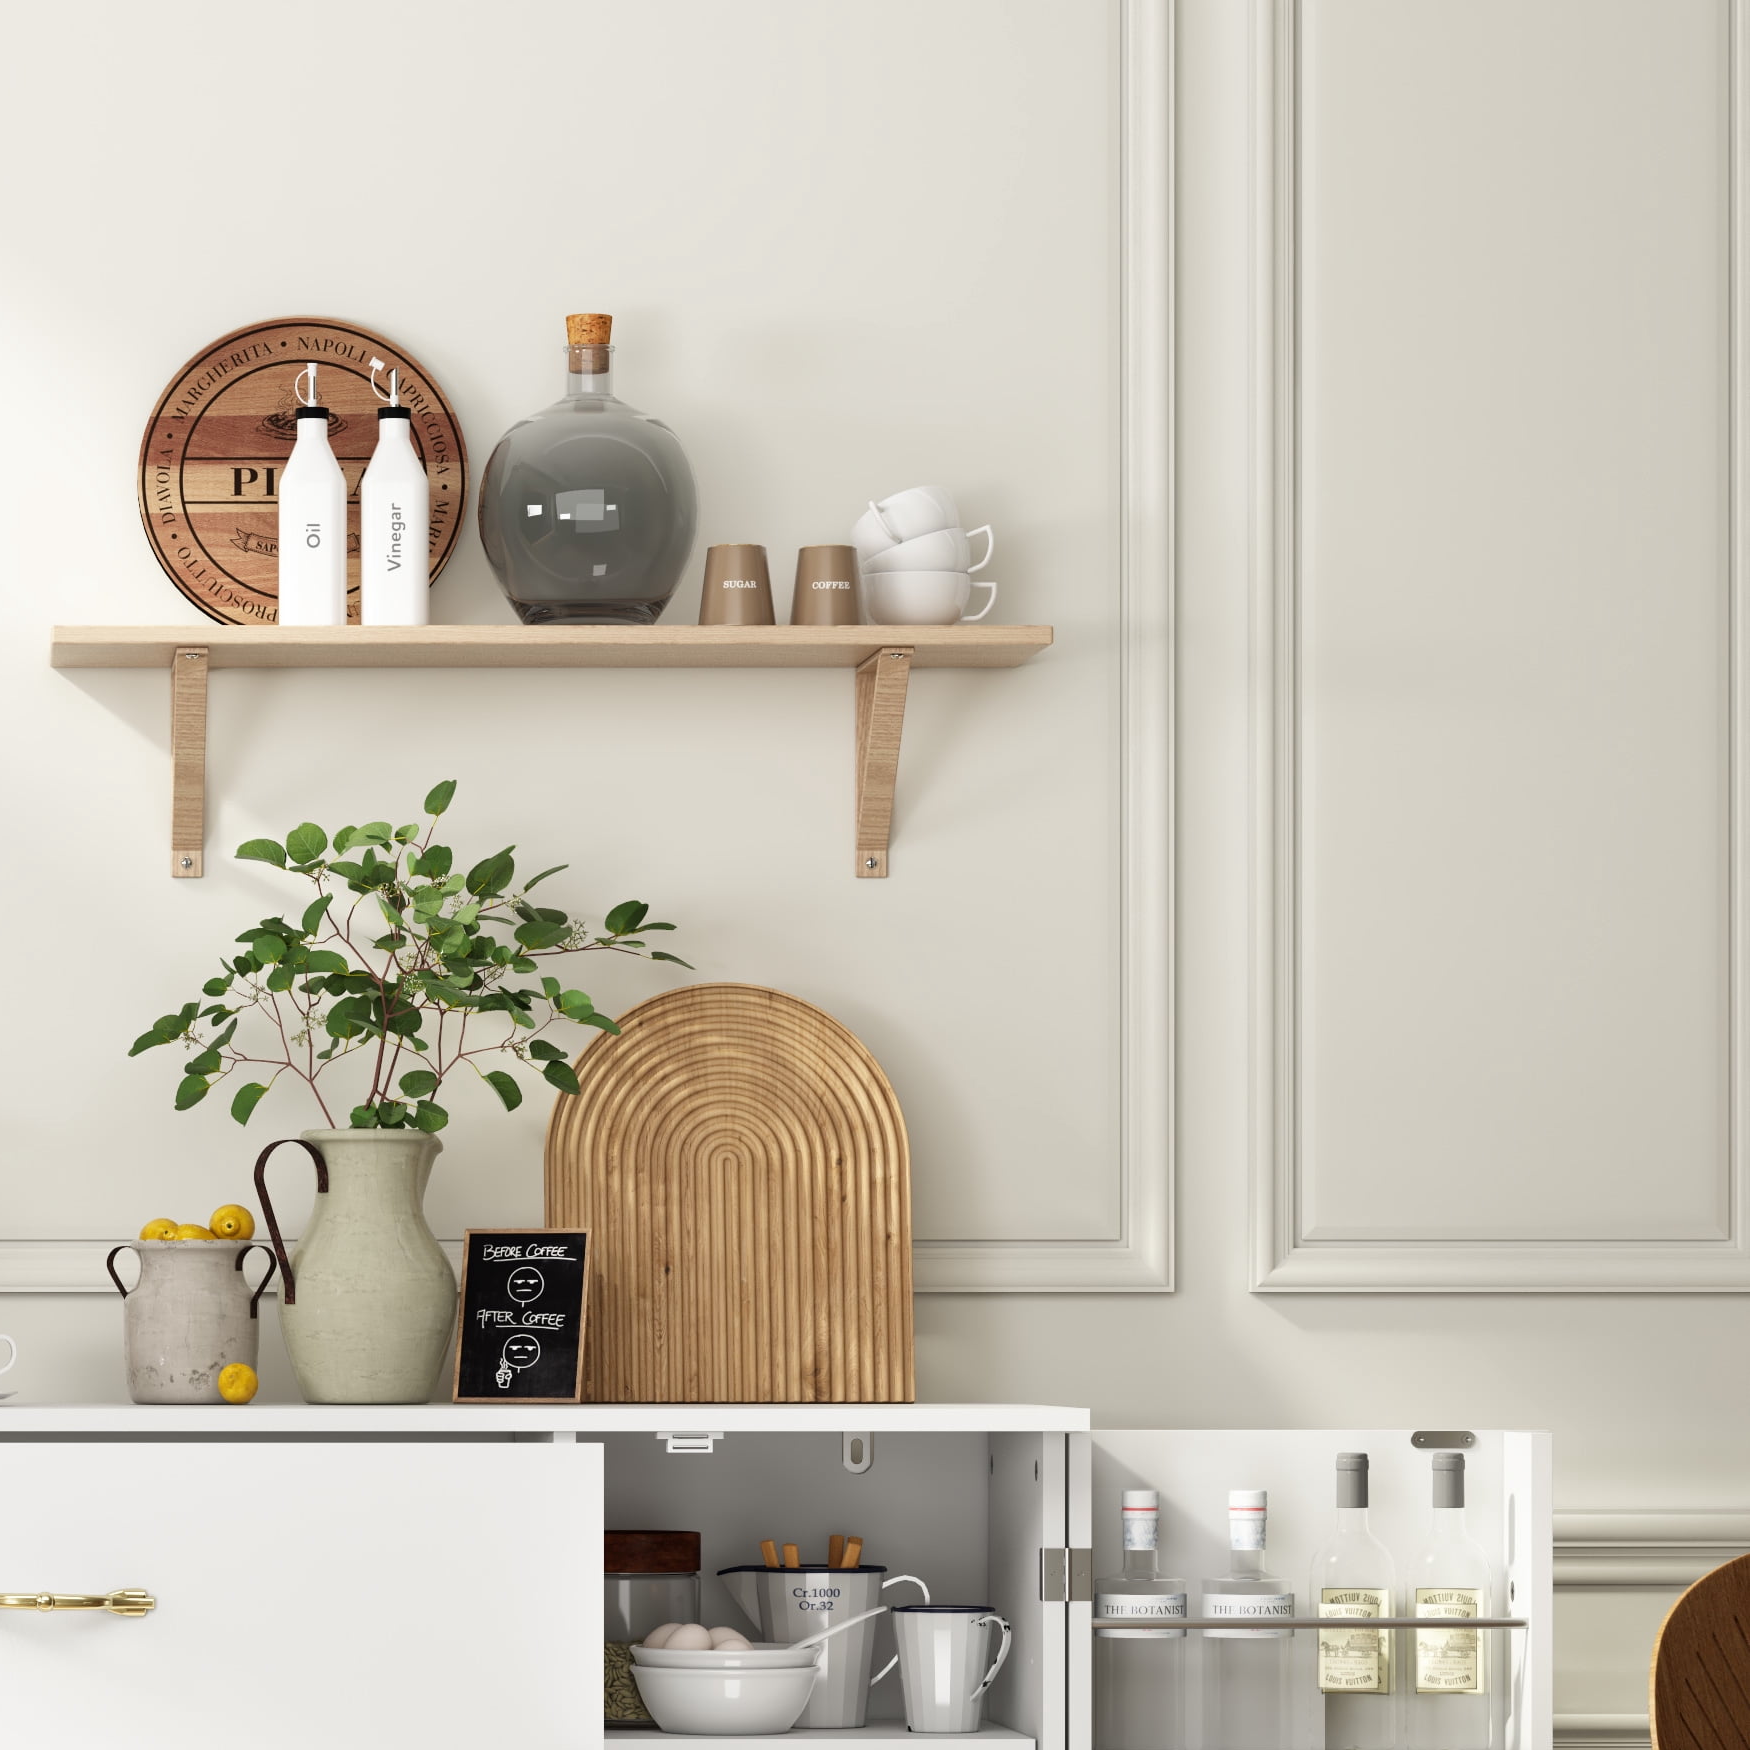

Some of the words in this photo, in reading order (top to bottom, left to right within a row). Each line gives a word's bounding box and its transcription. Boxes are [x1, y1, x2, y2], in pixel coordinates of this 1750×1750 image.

[297, 336, 367, 363] NAPOLI
[171, 342, 273, 424] MARGHERITA
[155, 449, 176, 525] DIAVOLA
[306, 523, 321, 548] Oil
[387, 502, 406, 572] Vinegar
[255, 541, 279, 553] SAP
[177, 546, 278, 622] PROSCIUTTO
[722, 580, 757, 589] SUGAR
[812, 581, 851, 590] COFFEE
[483, 1244, 522, 1260] BEFORE
[526, 1244, 568, 1258] COFFEE
[476, 1309, 517, 1328] AFTER
[522, 1311, 566, 1327] COFFEE
[792, 1587, 841, 1598] Cr.1000
[799, 1600, 834, 1611] Or.32
[1105, 1604, 1127, 1615] THE
[1131, 1604, 1184, 1616] BOTANIST
[1212, 1604, 1235, 1615] THE
[1239, 1604, 1292, 1616] BOTANIST
